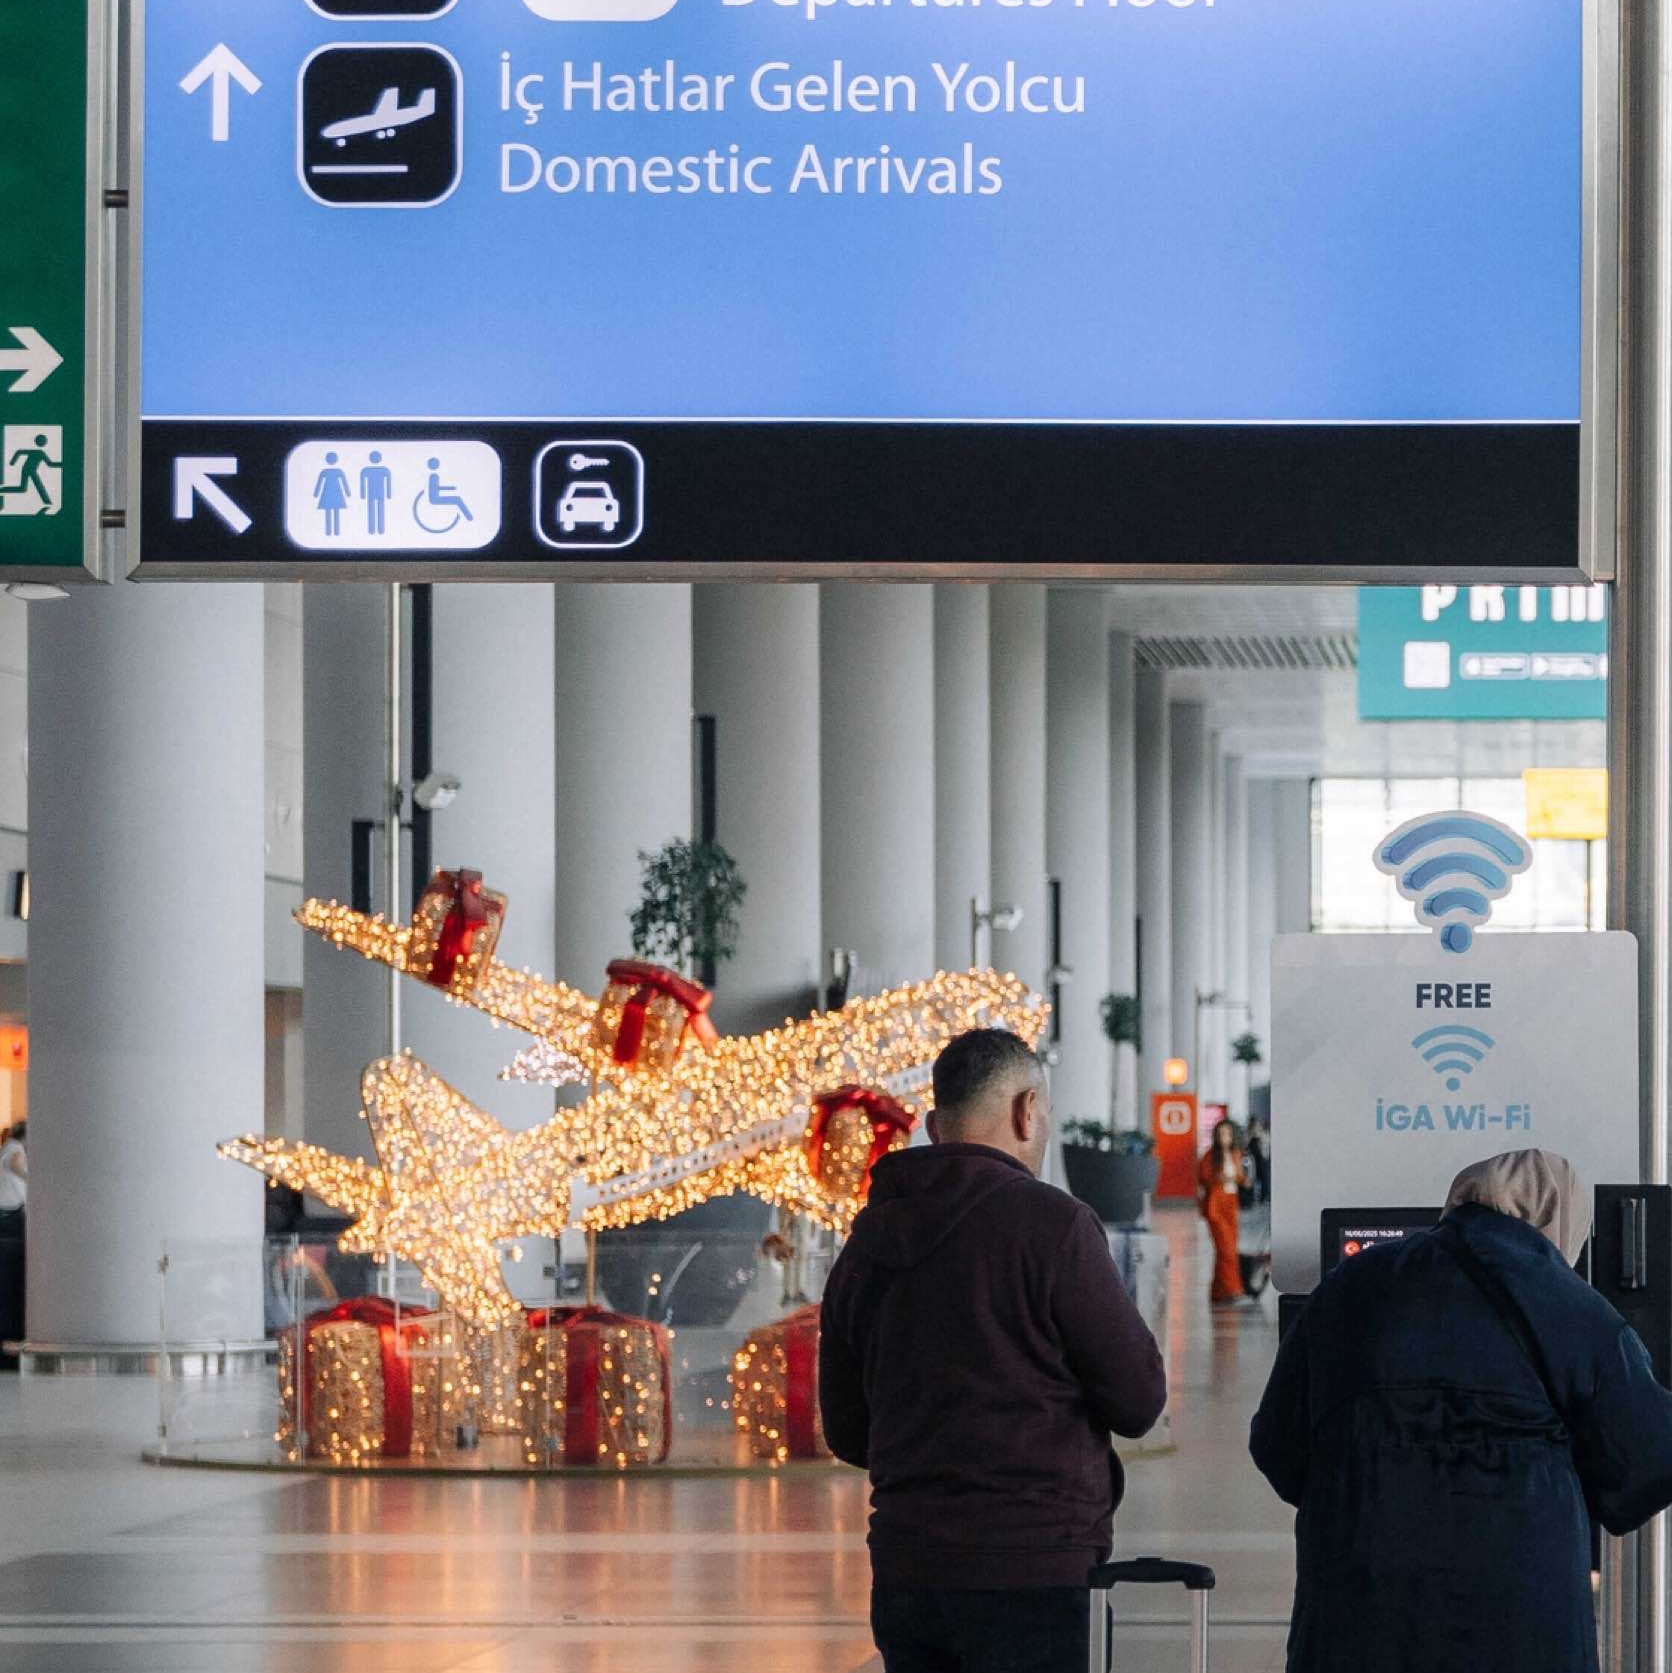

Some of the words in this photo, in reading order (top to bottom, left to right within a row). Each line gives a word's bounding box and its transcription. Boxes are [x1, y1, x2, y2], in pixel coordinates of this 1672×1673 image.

[500, 51, 544, 125] İç
[563, 59, 736, 112] Hatlar
[750, 59, 916, 113] Gelen
[931, 60, 1085, 113] Yolcu
[500, 142, 772, 194] Domestic
[789, 141, 1003, 195] Arrivals
[1416, 983, 1492, 1009] FREE
[1375, 1097, 1435, 1132] İGA
[1443, 1103, 1531, 1131] Wi-Fi
